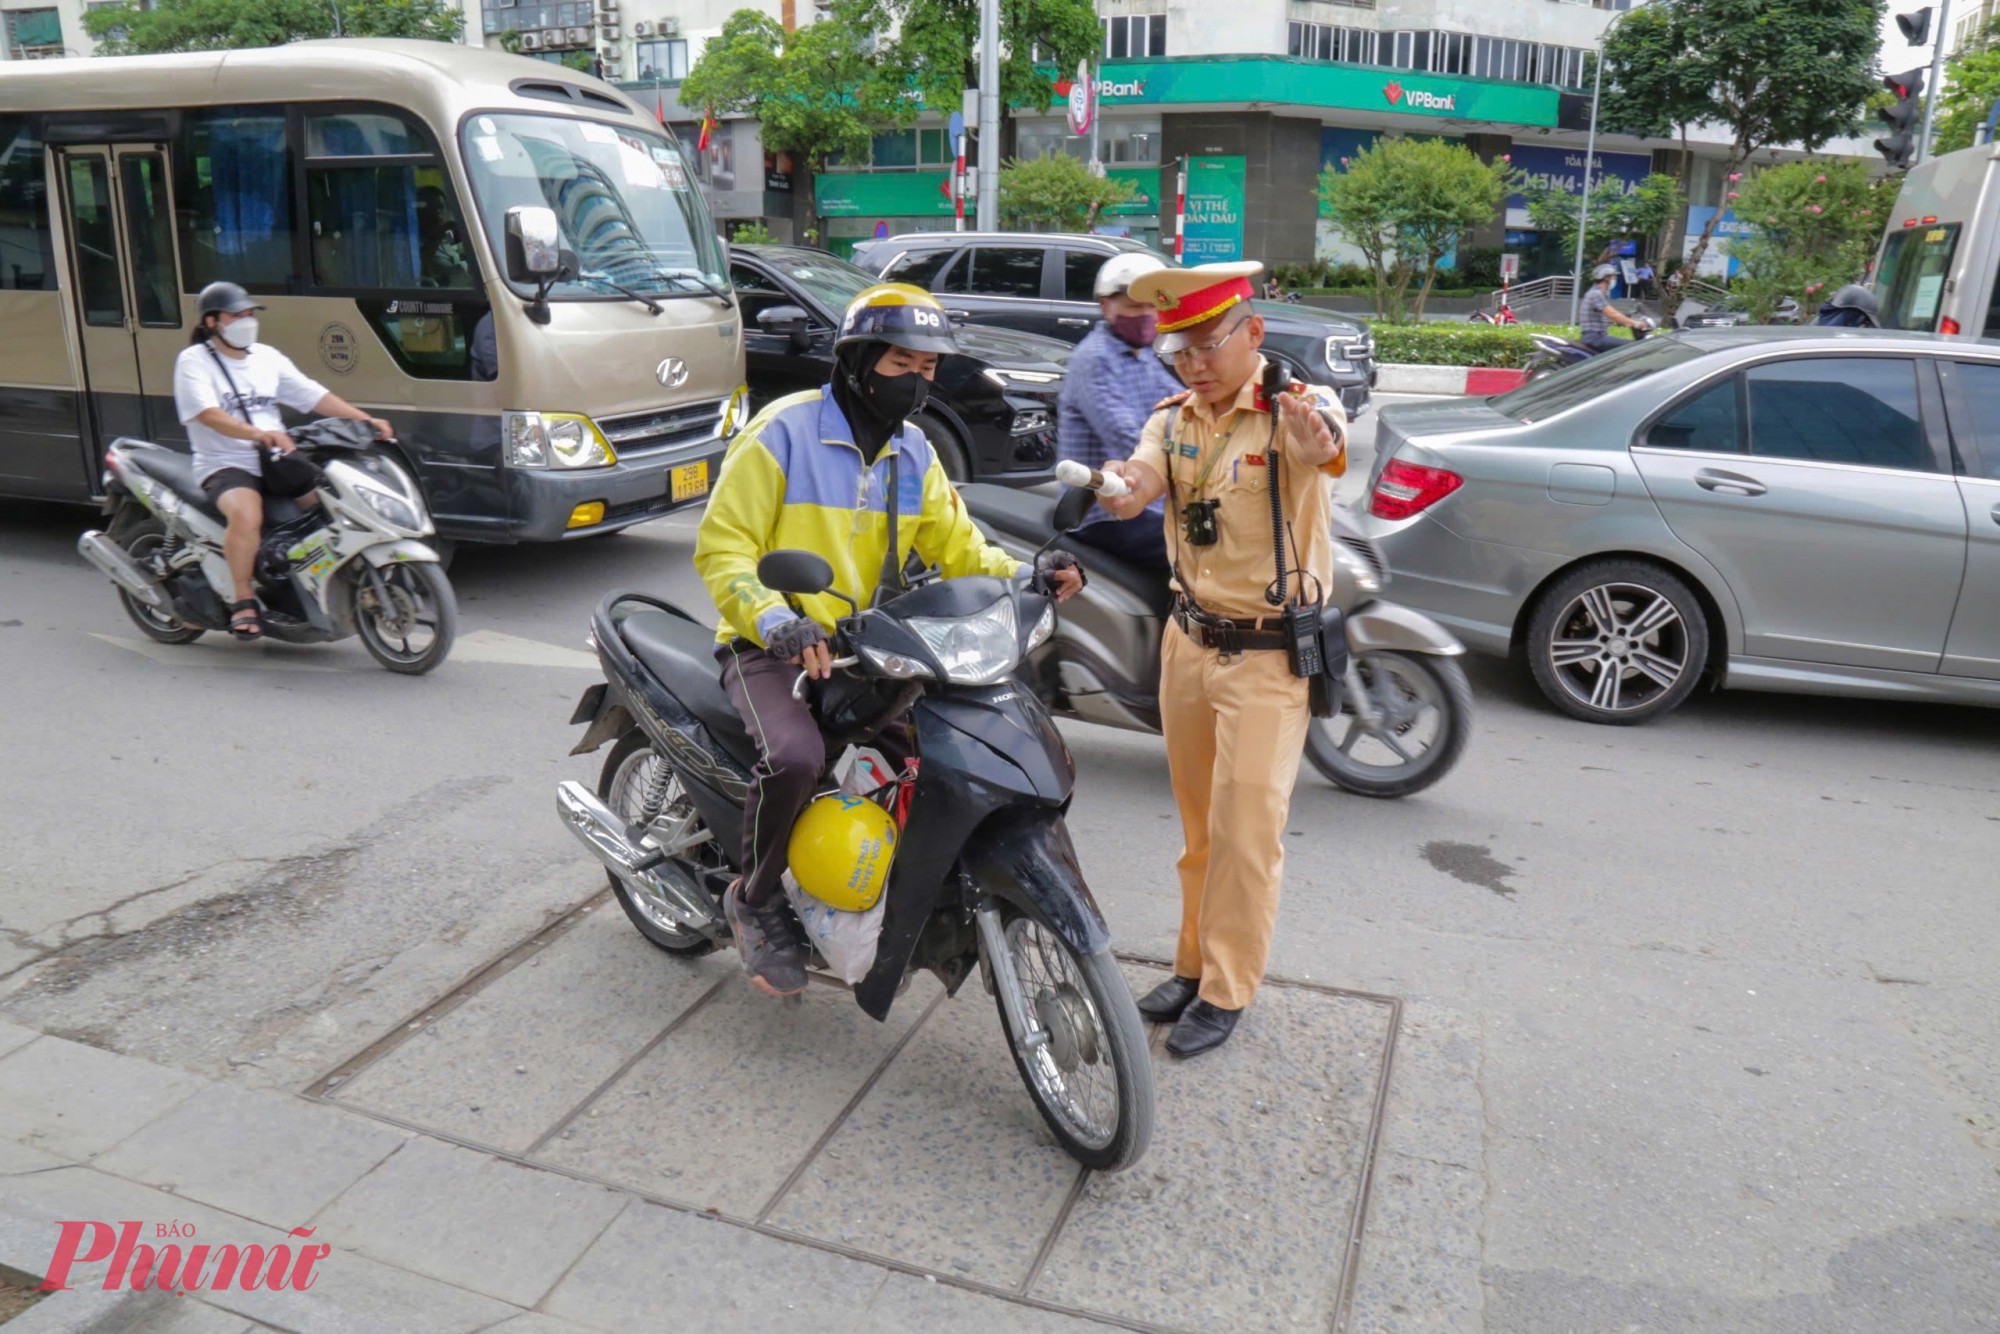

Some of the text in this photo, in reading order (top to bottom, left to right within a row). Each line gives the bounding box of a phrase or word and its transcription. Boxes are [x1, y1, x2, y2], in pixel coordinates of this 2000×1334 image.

[1405, 90, 1456, 110] VPBank
[1565, 154, 1581, 167] TÒA
[913, 308, 939, 327] be
[683, 465, 698, 481] 29B
